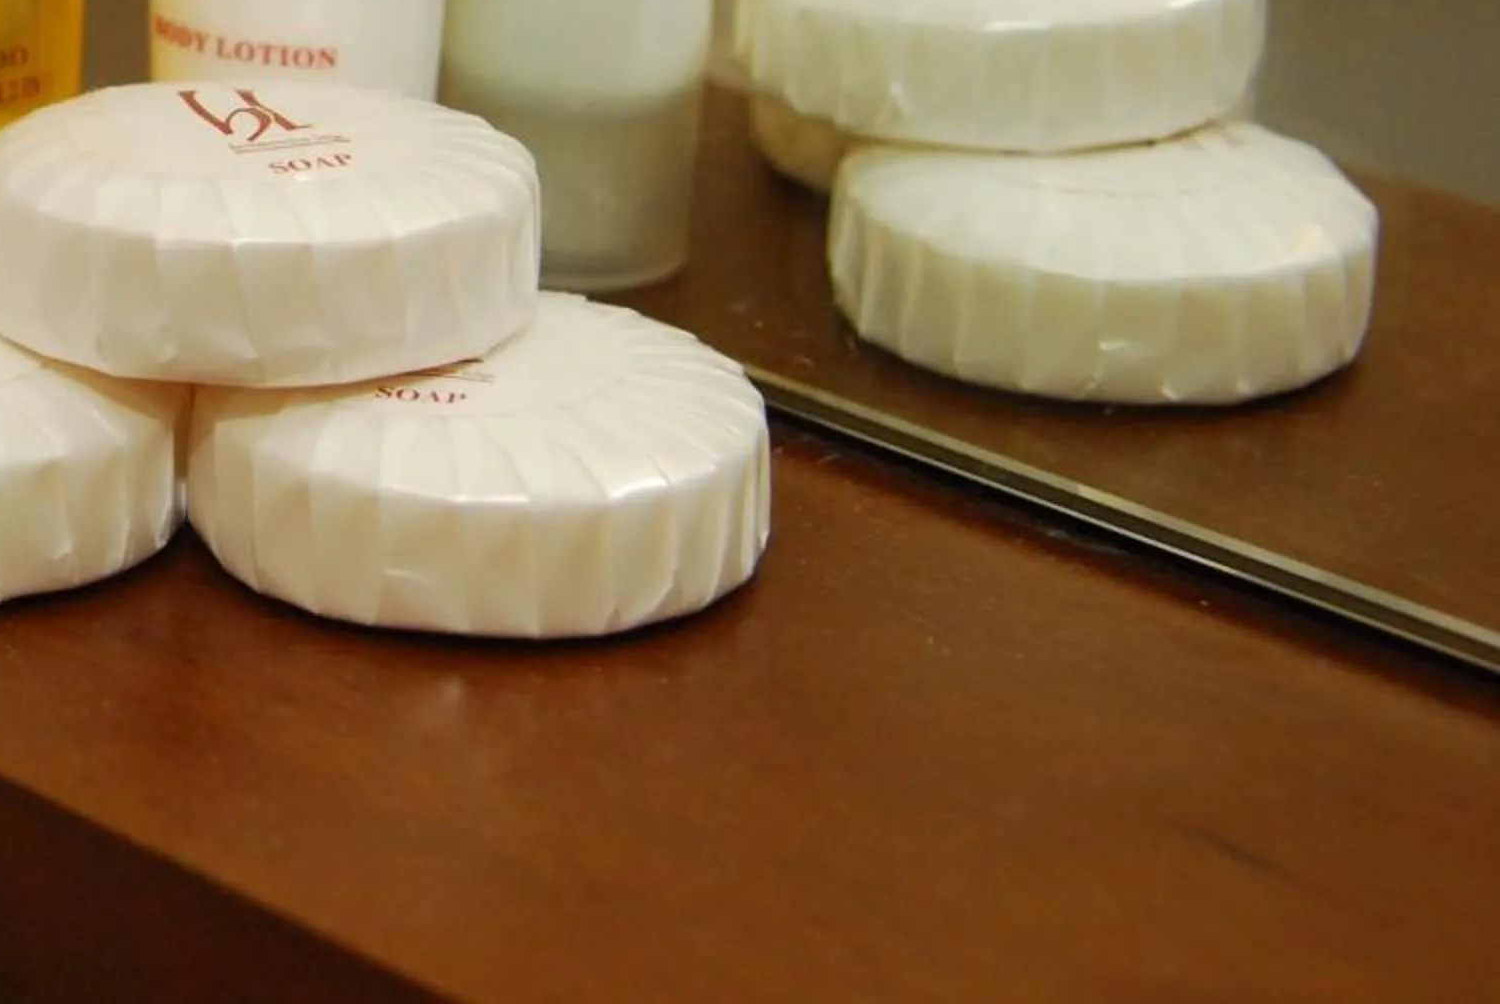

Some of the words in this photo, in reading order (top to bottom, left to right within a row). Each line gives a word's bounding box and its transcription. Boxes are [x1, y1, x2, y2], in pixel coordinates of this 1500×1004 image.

[215, 36, 339, 68] LOTION
[268, 153, 352, 174] SOAP
[376, 387, 467, 404] SOAP
